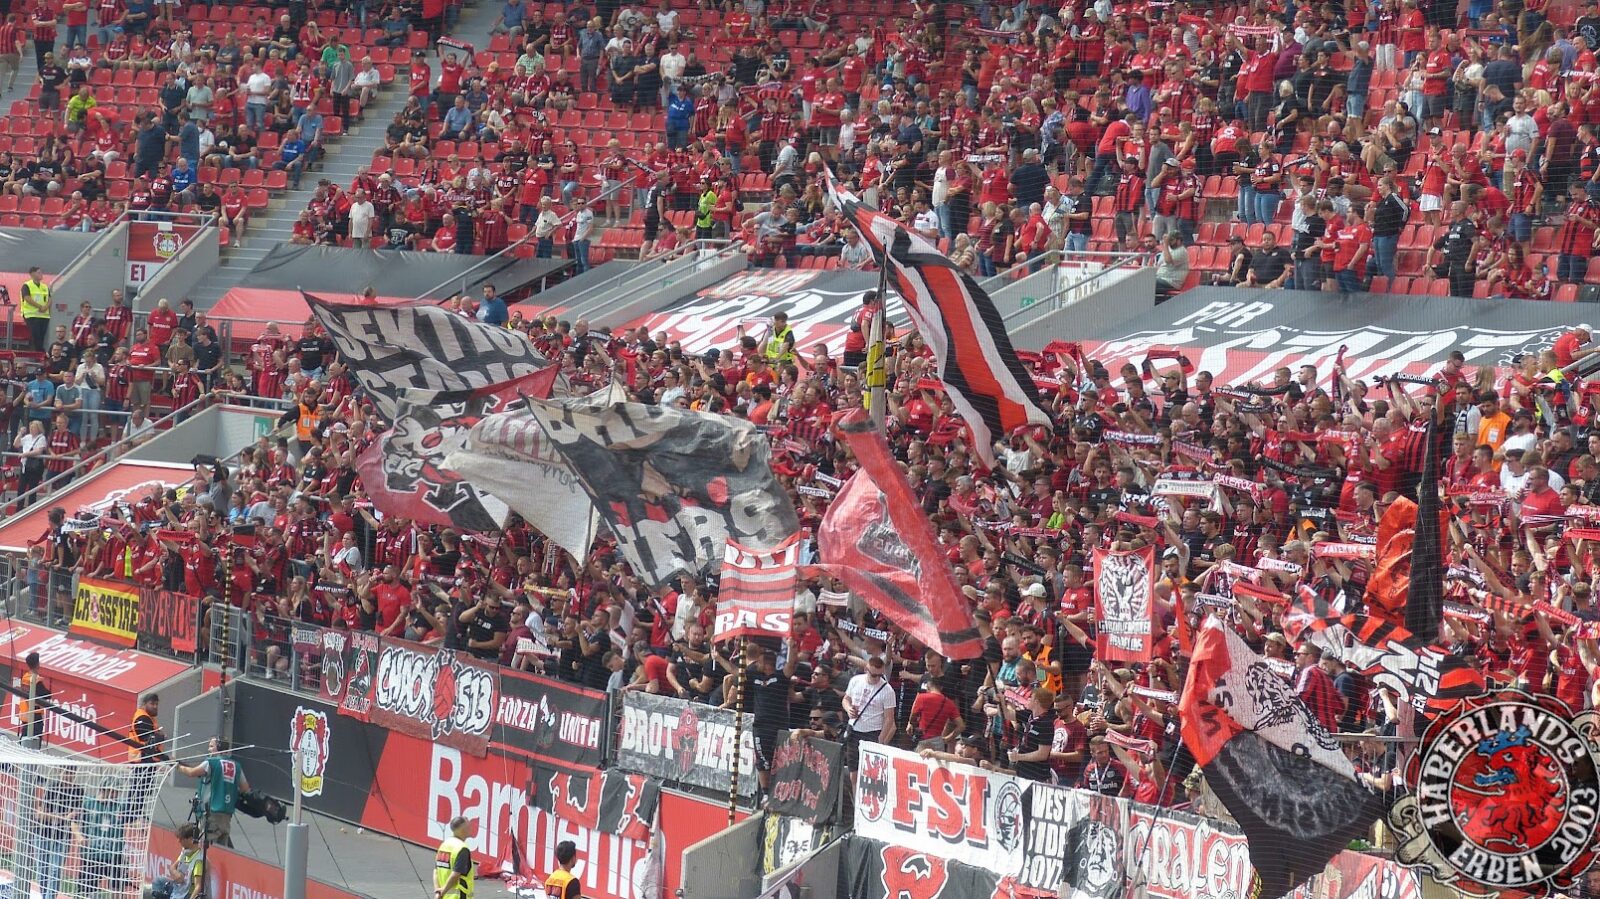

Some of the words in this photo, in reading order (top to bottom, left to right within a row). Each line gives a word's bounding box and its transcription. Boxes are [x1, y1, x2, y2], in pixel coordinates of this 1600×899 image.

[130, 263, 146, 282] E1
[724, 541, 799, 570] ULT
[714, 609, 791, 636] RAS
[10, 676, 98, 746] Bmenia
[455, 668, 494, 735] 513
[496, 696, 539, 732] FORZA
[558, 711, 601, 748] UNITA
[620, 705, 679, 760] BROT
[892, 756, 990, 850] FSI
[1030, 784, 1073, 824] WEST
